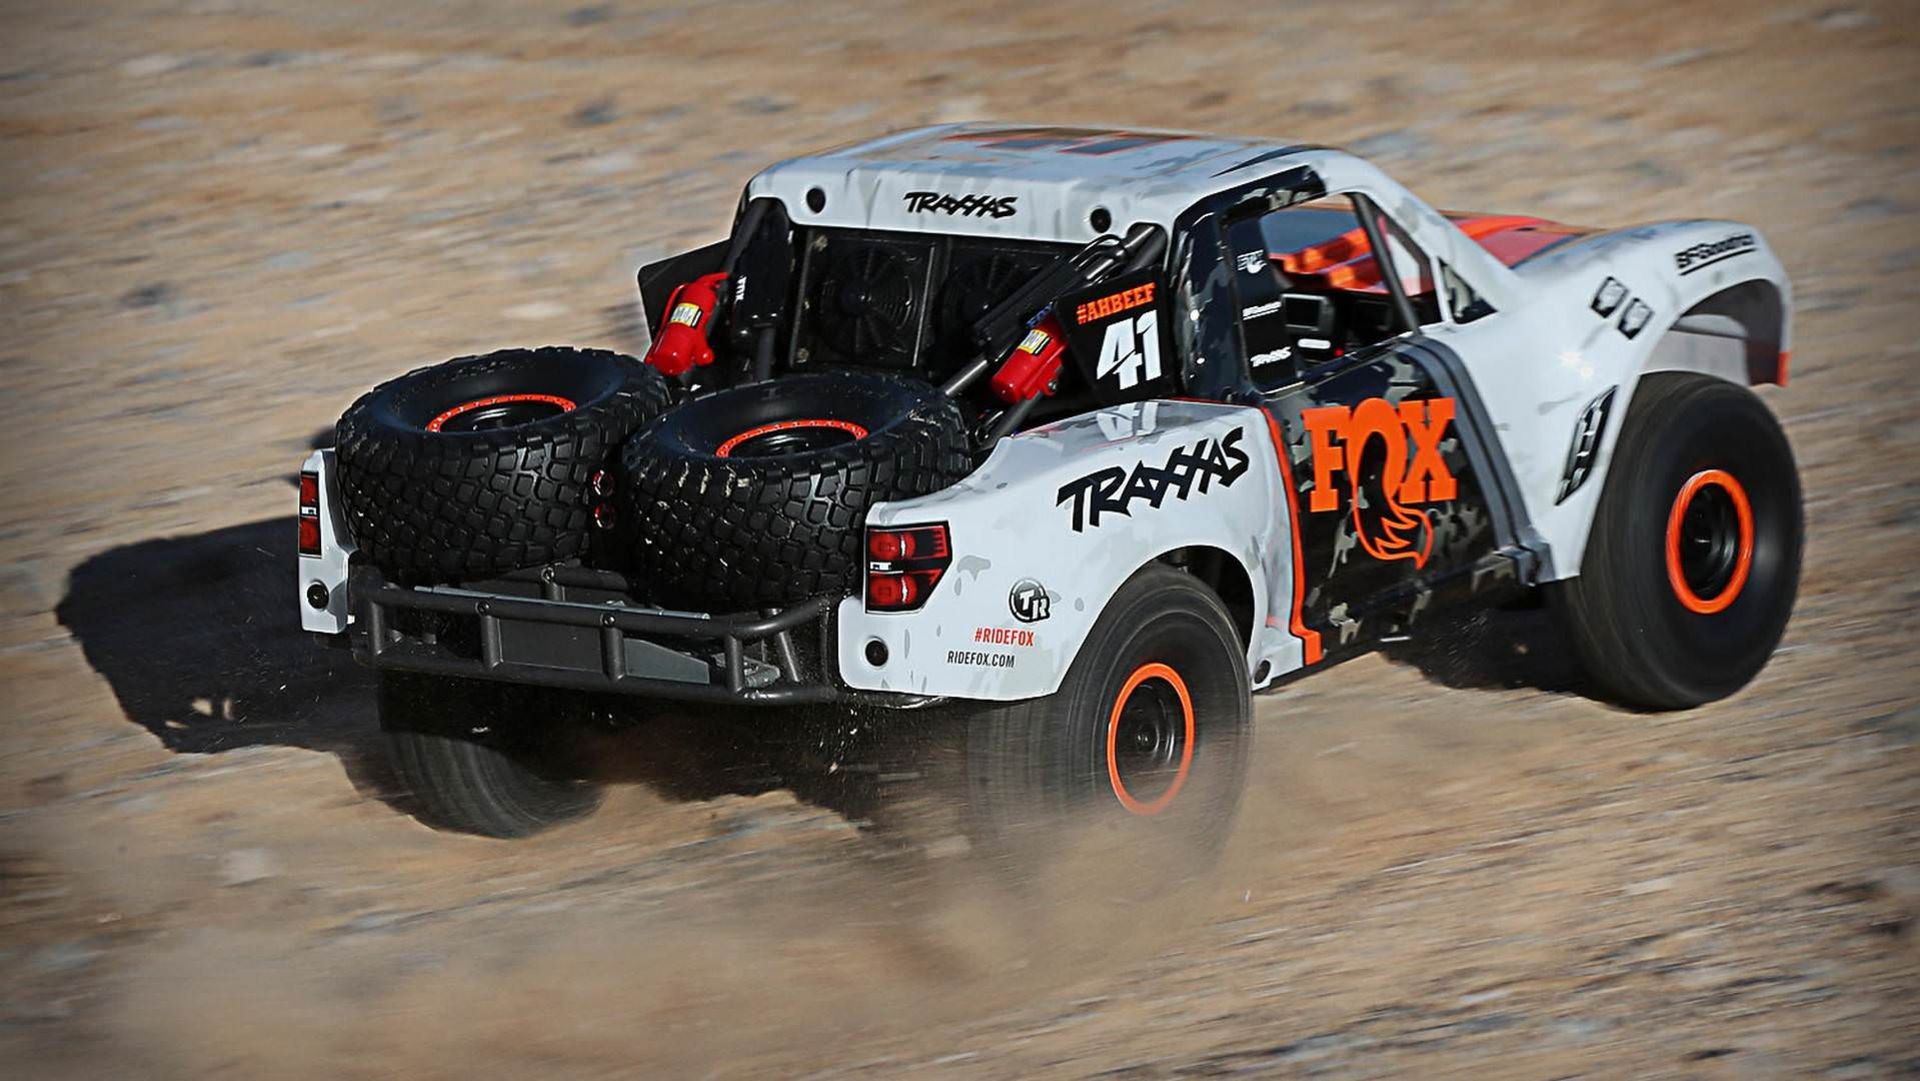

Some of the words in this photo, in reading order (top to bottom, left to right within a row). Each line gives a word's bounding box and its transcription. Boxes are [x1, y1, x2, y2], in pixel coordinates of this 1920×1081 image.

[903, 191, 1018, 219] TRAXXAS
[1076, 282, 1156, 325] #AHBEEF
[1096, 309, 1161, 390] 41
[1056, 426, 1250, 533] TRAXXAS
[1302, 397, 1457, 569] FOX
[975, 627, 1035, 647] #RIDEFOX
[947, 650, 1016, 668] RIDEFOX.COM
